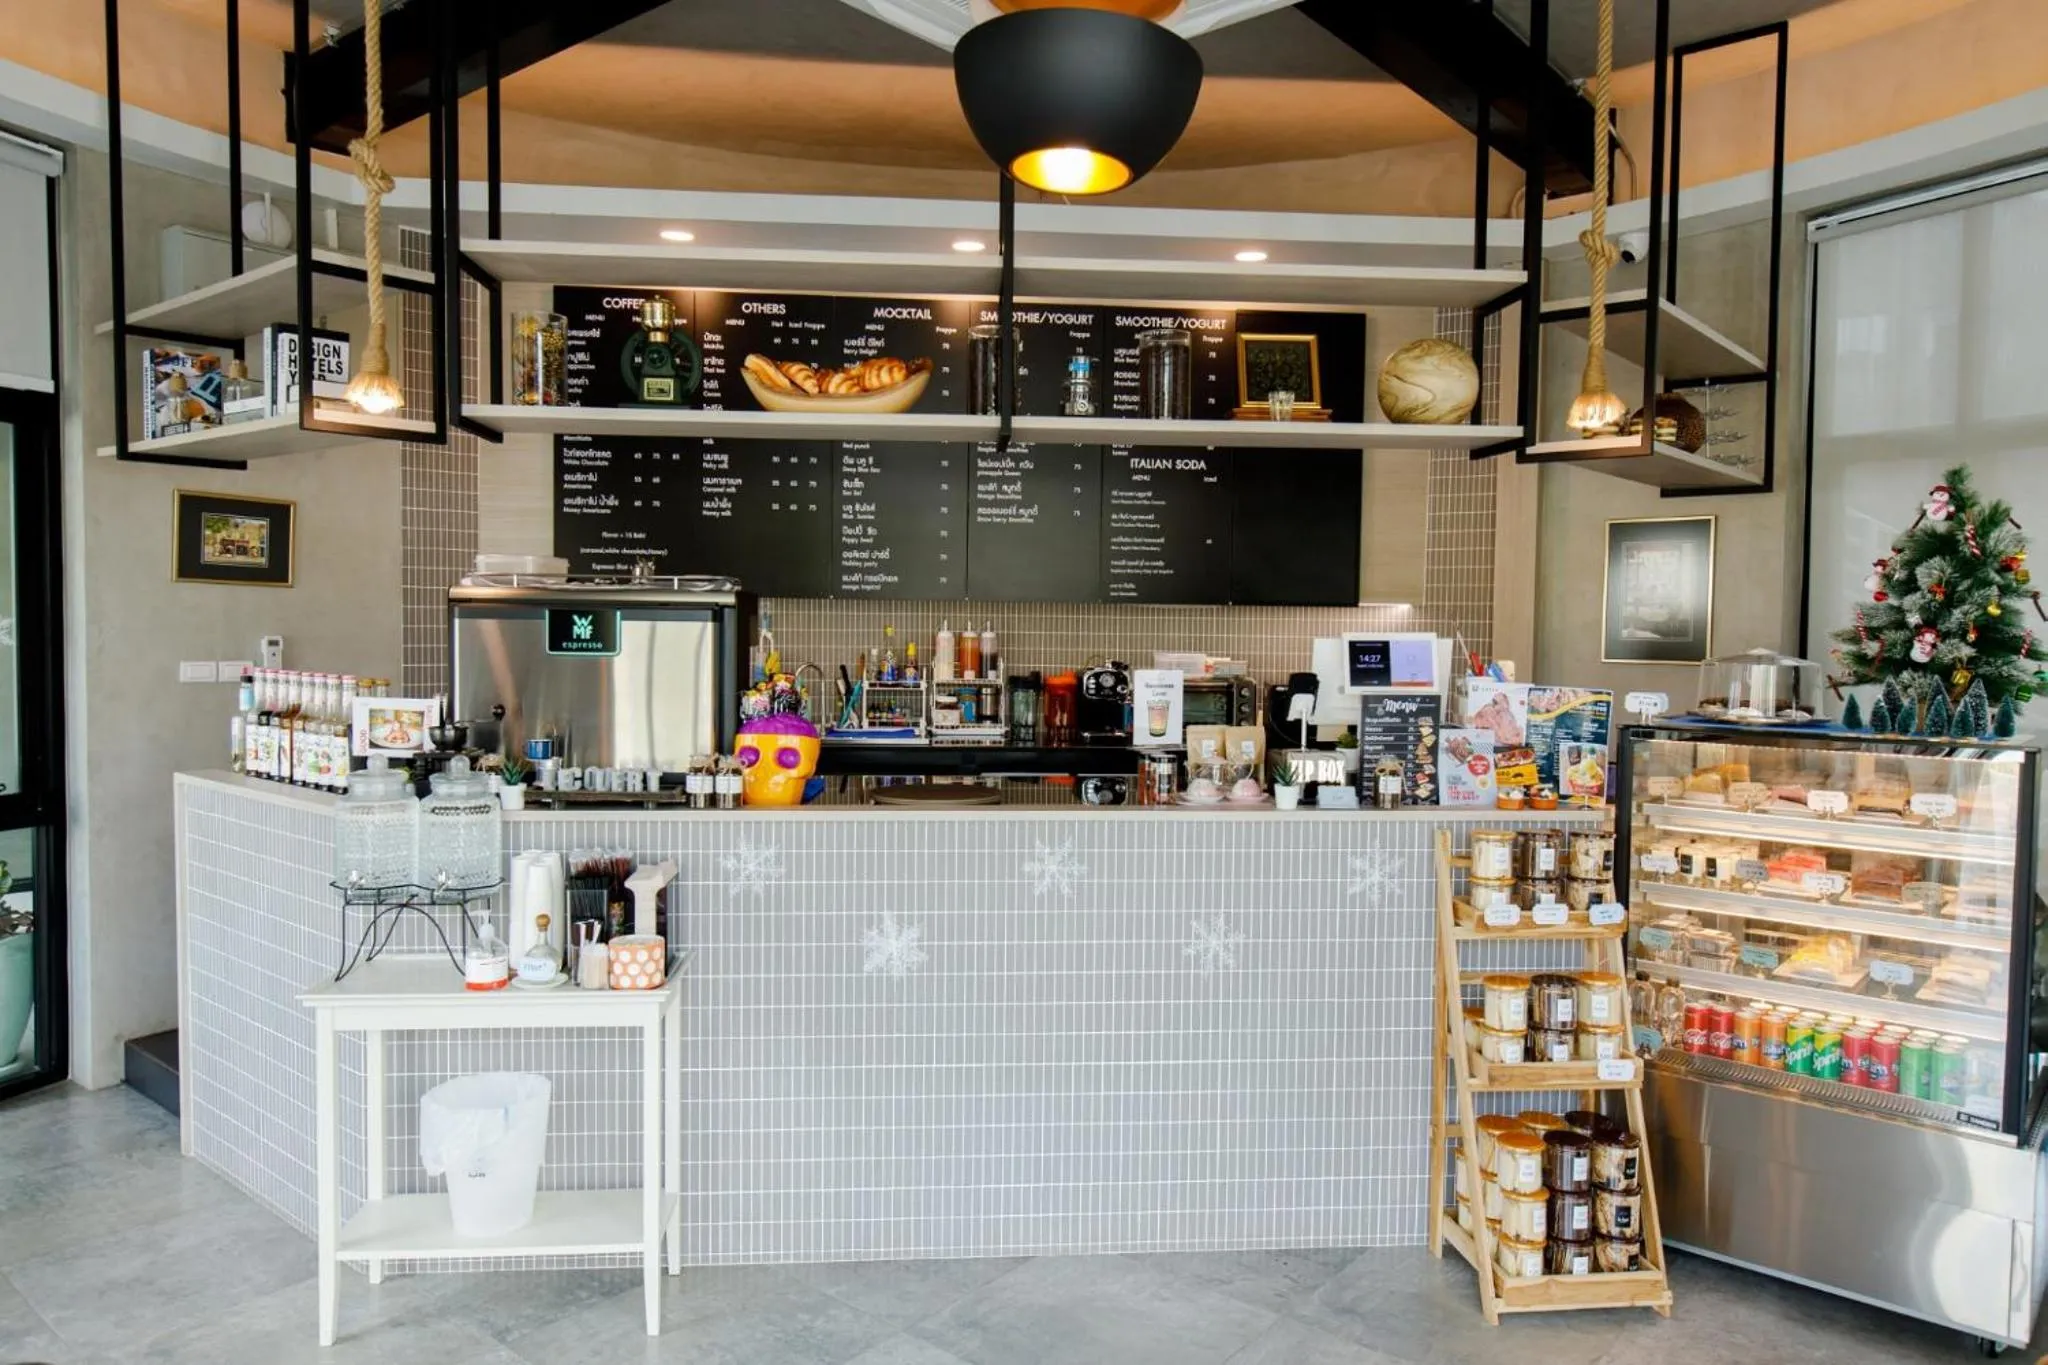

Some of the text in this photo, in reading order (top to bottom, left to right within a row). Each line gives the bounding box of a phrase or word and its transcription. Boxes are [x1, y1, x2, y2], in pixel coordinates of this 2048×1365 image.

[741, 302, 786, 315] OTHERS
[873, 307, 932, 320] MOCKTAIL
[980, 310, 1094, 325] SMTHIE/YOGURT
[1115, 315, 1227, 329] SMOOTHIE/YOGURT
[865, 323, 885, 331] MENU
[289, 338, 341, 360] DIGN
[1130, 458, 1207, 470] ITALIAN SODA
[562, 642, 603, 650] espresso
[1359, 654, 1381, 663] 14:27
[1383, 698, 1419, 714] Menu
[1318, 759, 1346, 785] BOX
